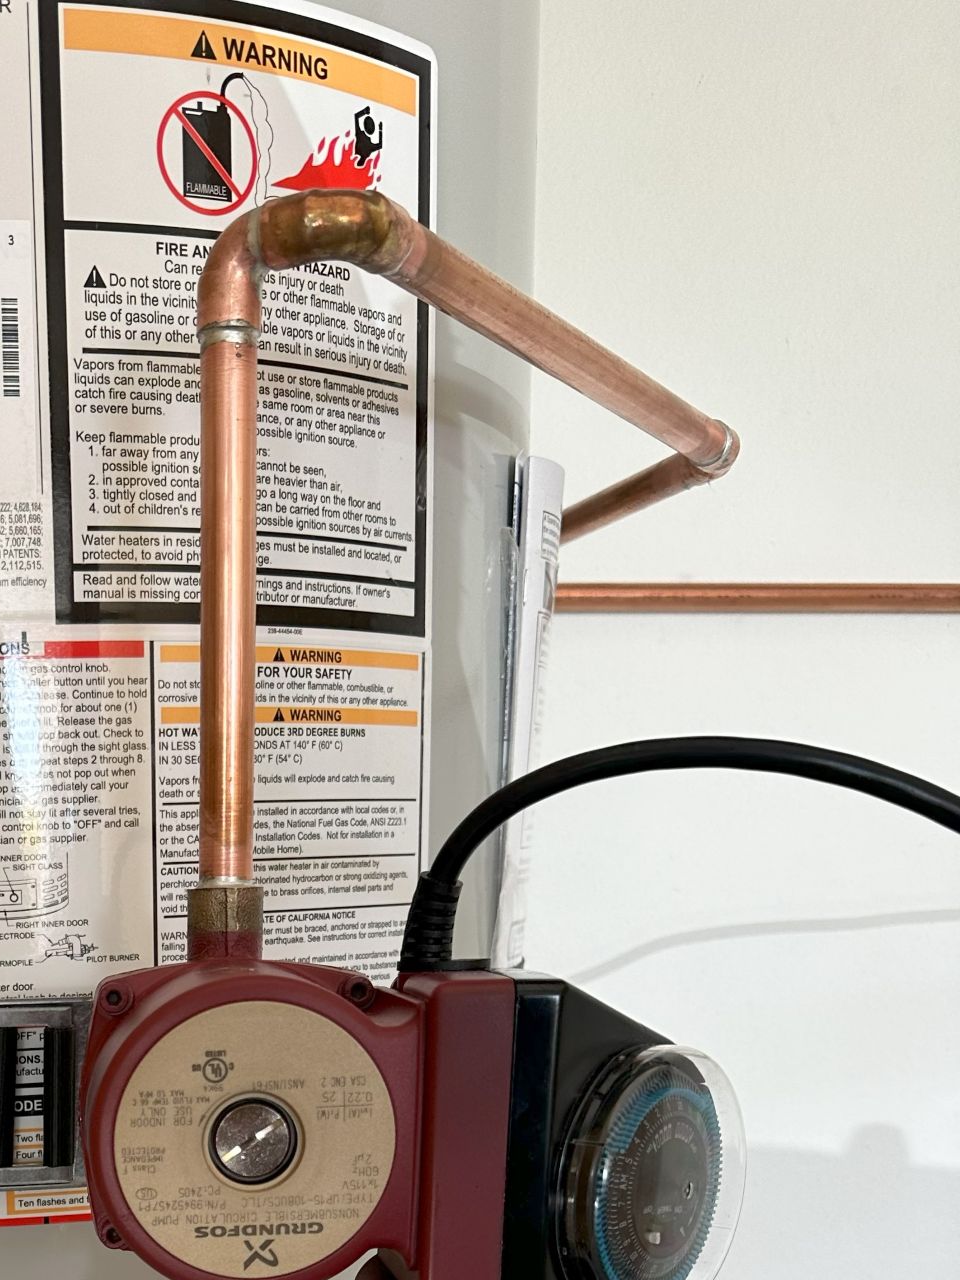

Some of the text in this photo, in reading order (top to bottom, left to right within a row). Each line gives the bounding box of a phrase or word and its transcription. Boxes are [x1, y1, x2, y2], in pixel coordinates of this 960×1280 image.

[223, 37, 328, 79] WARNING
[186, 183, 226, 197] FLAMMABLE
[8, 234, 14, 246] 3
[304, 263, 350, 281] HAZARD
[73, 358, 203, 378] Vapors from flammable
[290, 650, 342, 663] WARNING
[257, 666, 352, 680] FOR YOUR SAFETY
[290, 709, 341, 722] WARNING
[287, 727, 366, 737] 3RD DEGREE BURNS
[287, 910, 356, 922] CALIFORNIA NOTICE
[86, 953, 140, 963] PILOT BURNER
[140, 1107, 192, 1116] USE ONLY
[130, 1117, 193, 1127] FOR INDOOR
[151, 1208, 359, 1225] NONSUBMERSIBLE CIRCULATION PUMP
[194, 1223, 324, 1238] GRUNDFOS
